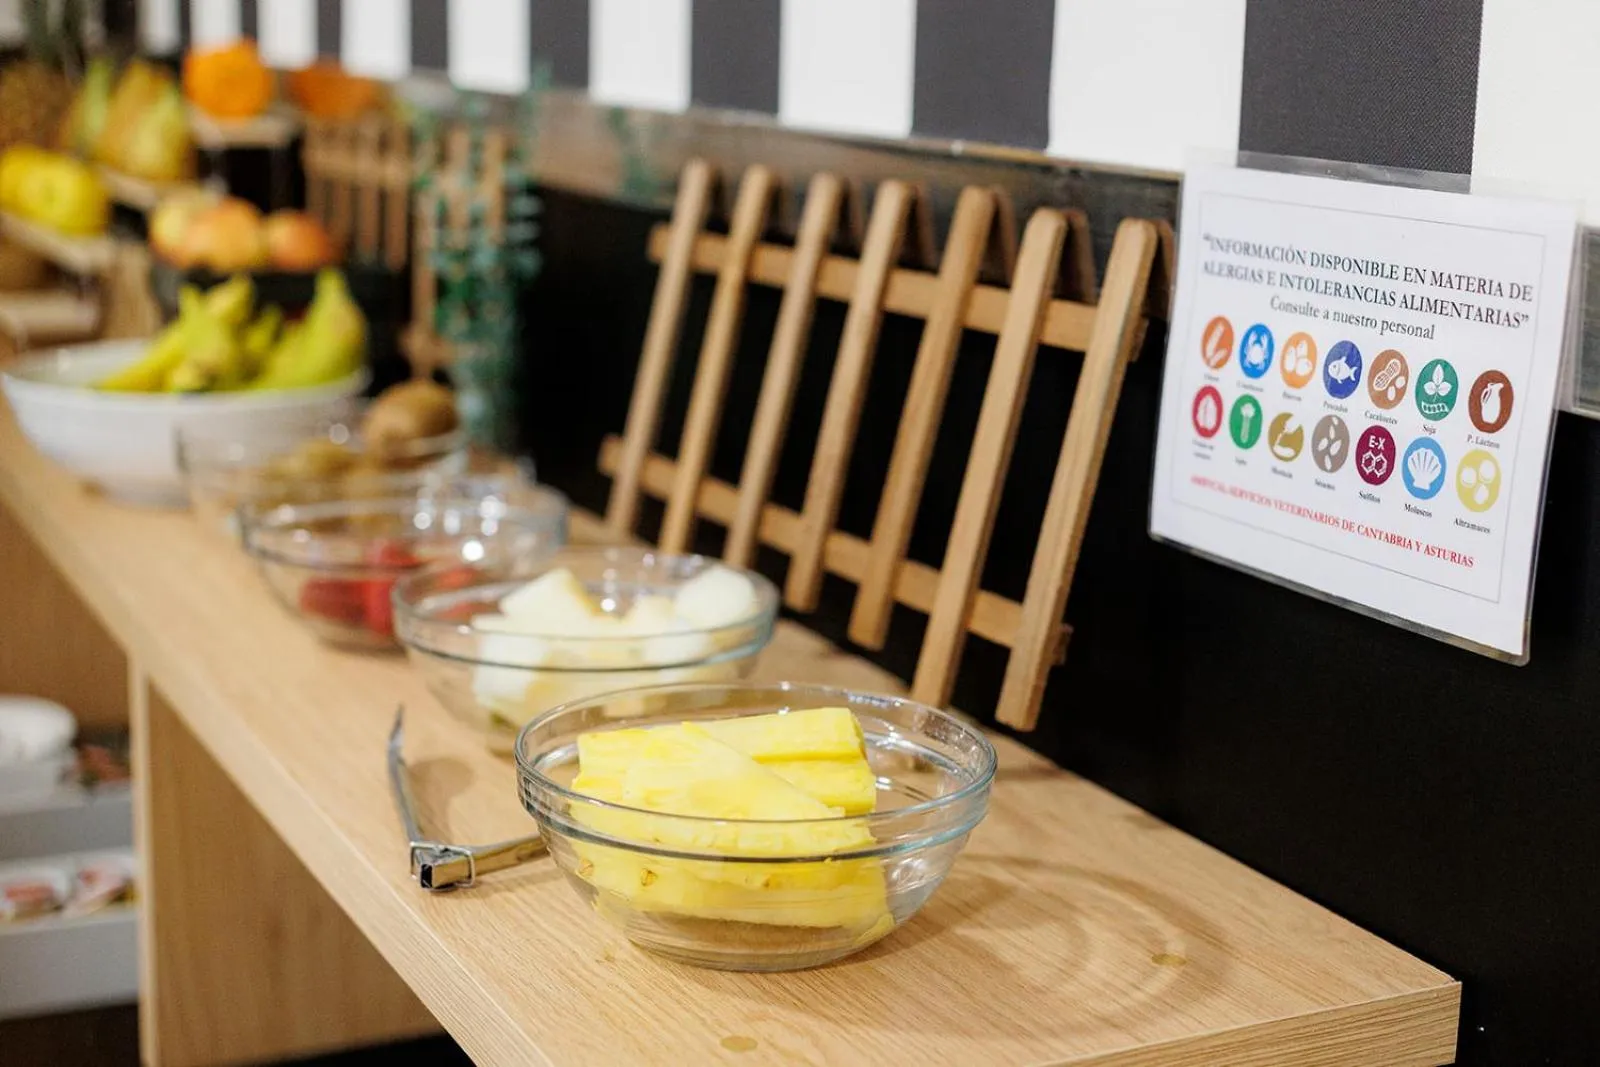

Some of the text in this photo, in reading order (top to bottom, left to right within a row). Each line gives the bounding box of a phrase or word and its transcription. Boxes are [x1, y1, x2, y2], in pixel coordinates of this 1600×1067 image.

[1203, 260, 1264, 284] ALERGIAS
[1267, 271, 1276, 286] E
[1279, 272, 1396, 307] INTOLERANCIAS
[1310, 252, 1399, 281] DISPONIBLE
[1403, 266, 1427, 284] EN
[1430, 270, 1504, 297] MATERIA
[1508, 282, 1533, 302] DE
[1270, 294, 1435, 339] Consulte a nuestro personal
[1273, 499, 1340, 527] VETERINARIOS
[1342, 519, 1355, 532] DE
[1357, 525, 1413, 550] CANTABRIA
[1415, 541, 1423, 552] Y
[1424, 544, 1474, 568] ASTURIAS
